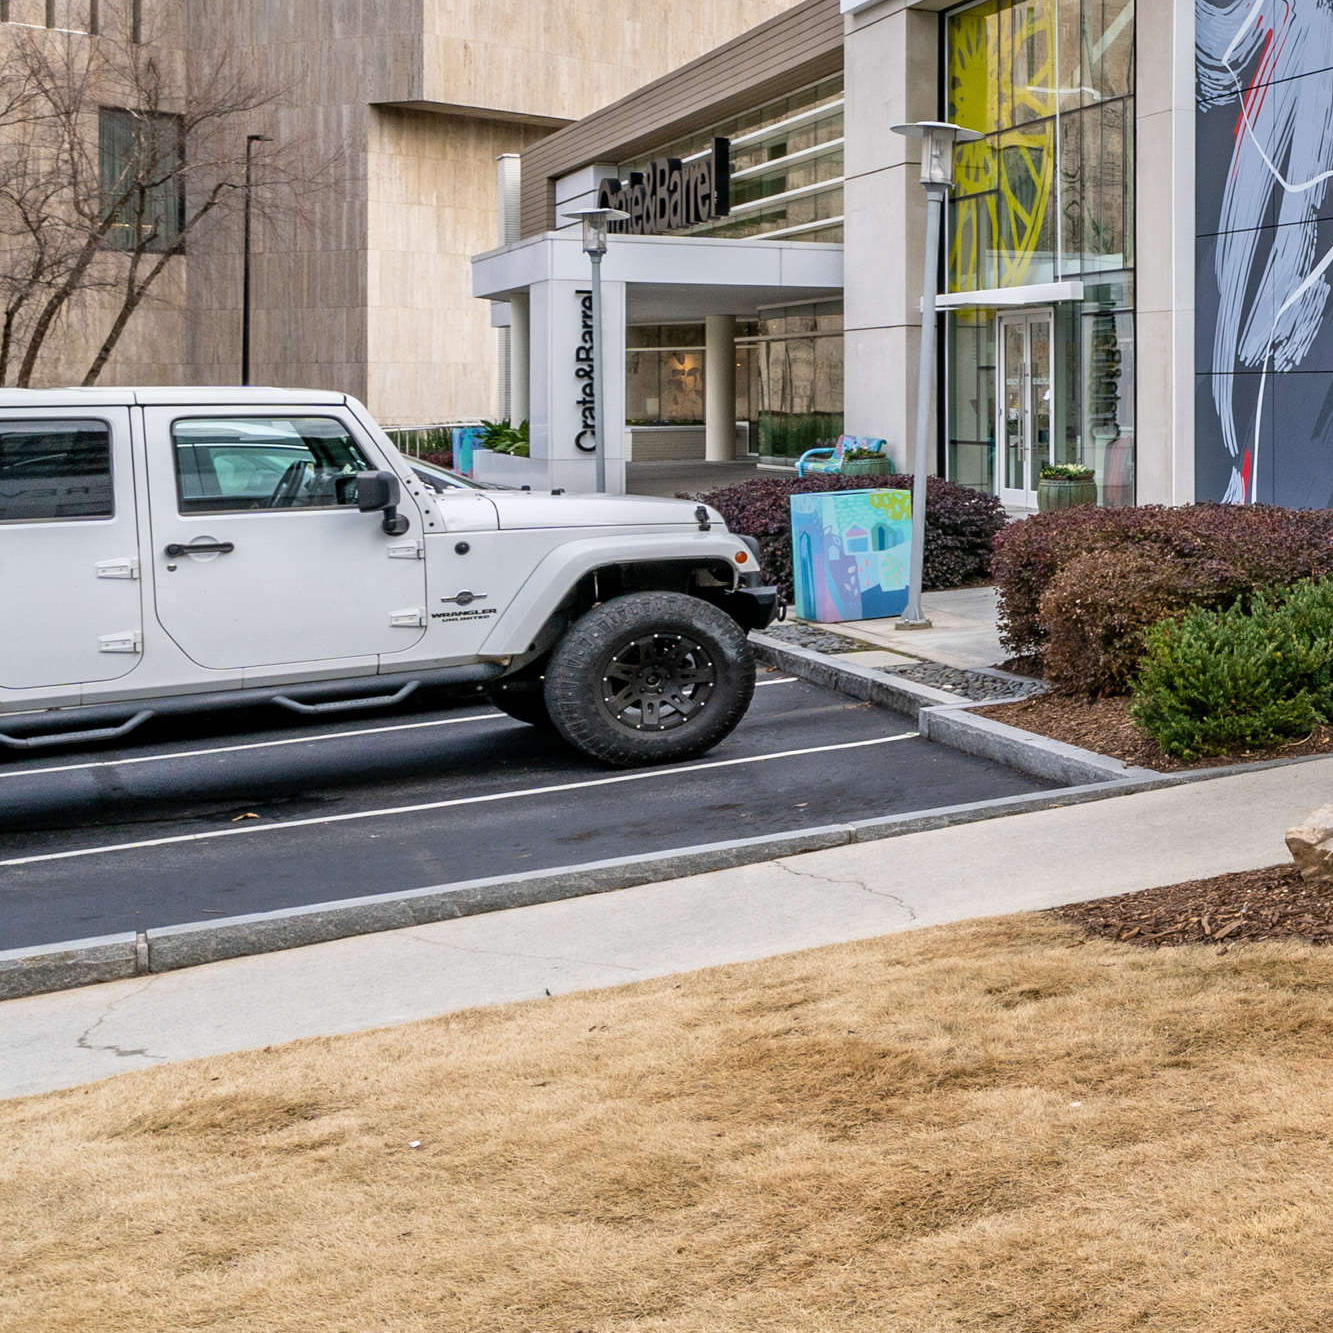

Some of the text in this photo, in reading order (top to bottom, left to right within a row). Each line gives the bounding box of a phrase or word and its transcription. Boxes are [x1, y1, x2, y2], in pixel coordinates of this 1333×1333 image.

[574, 289, 597, 453] Crate&Barrel
[431, 608, 497, 618] WRANGLER
[442, 615, 490, 623] UNLIMITED
